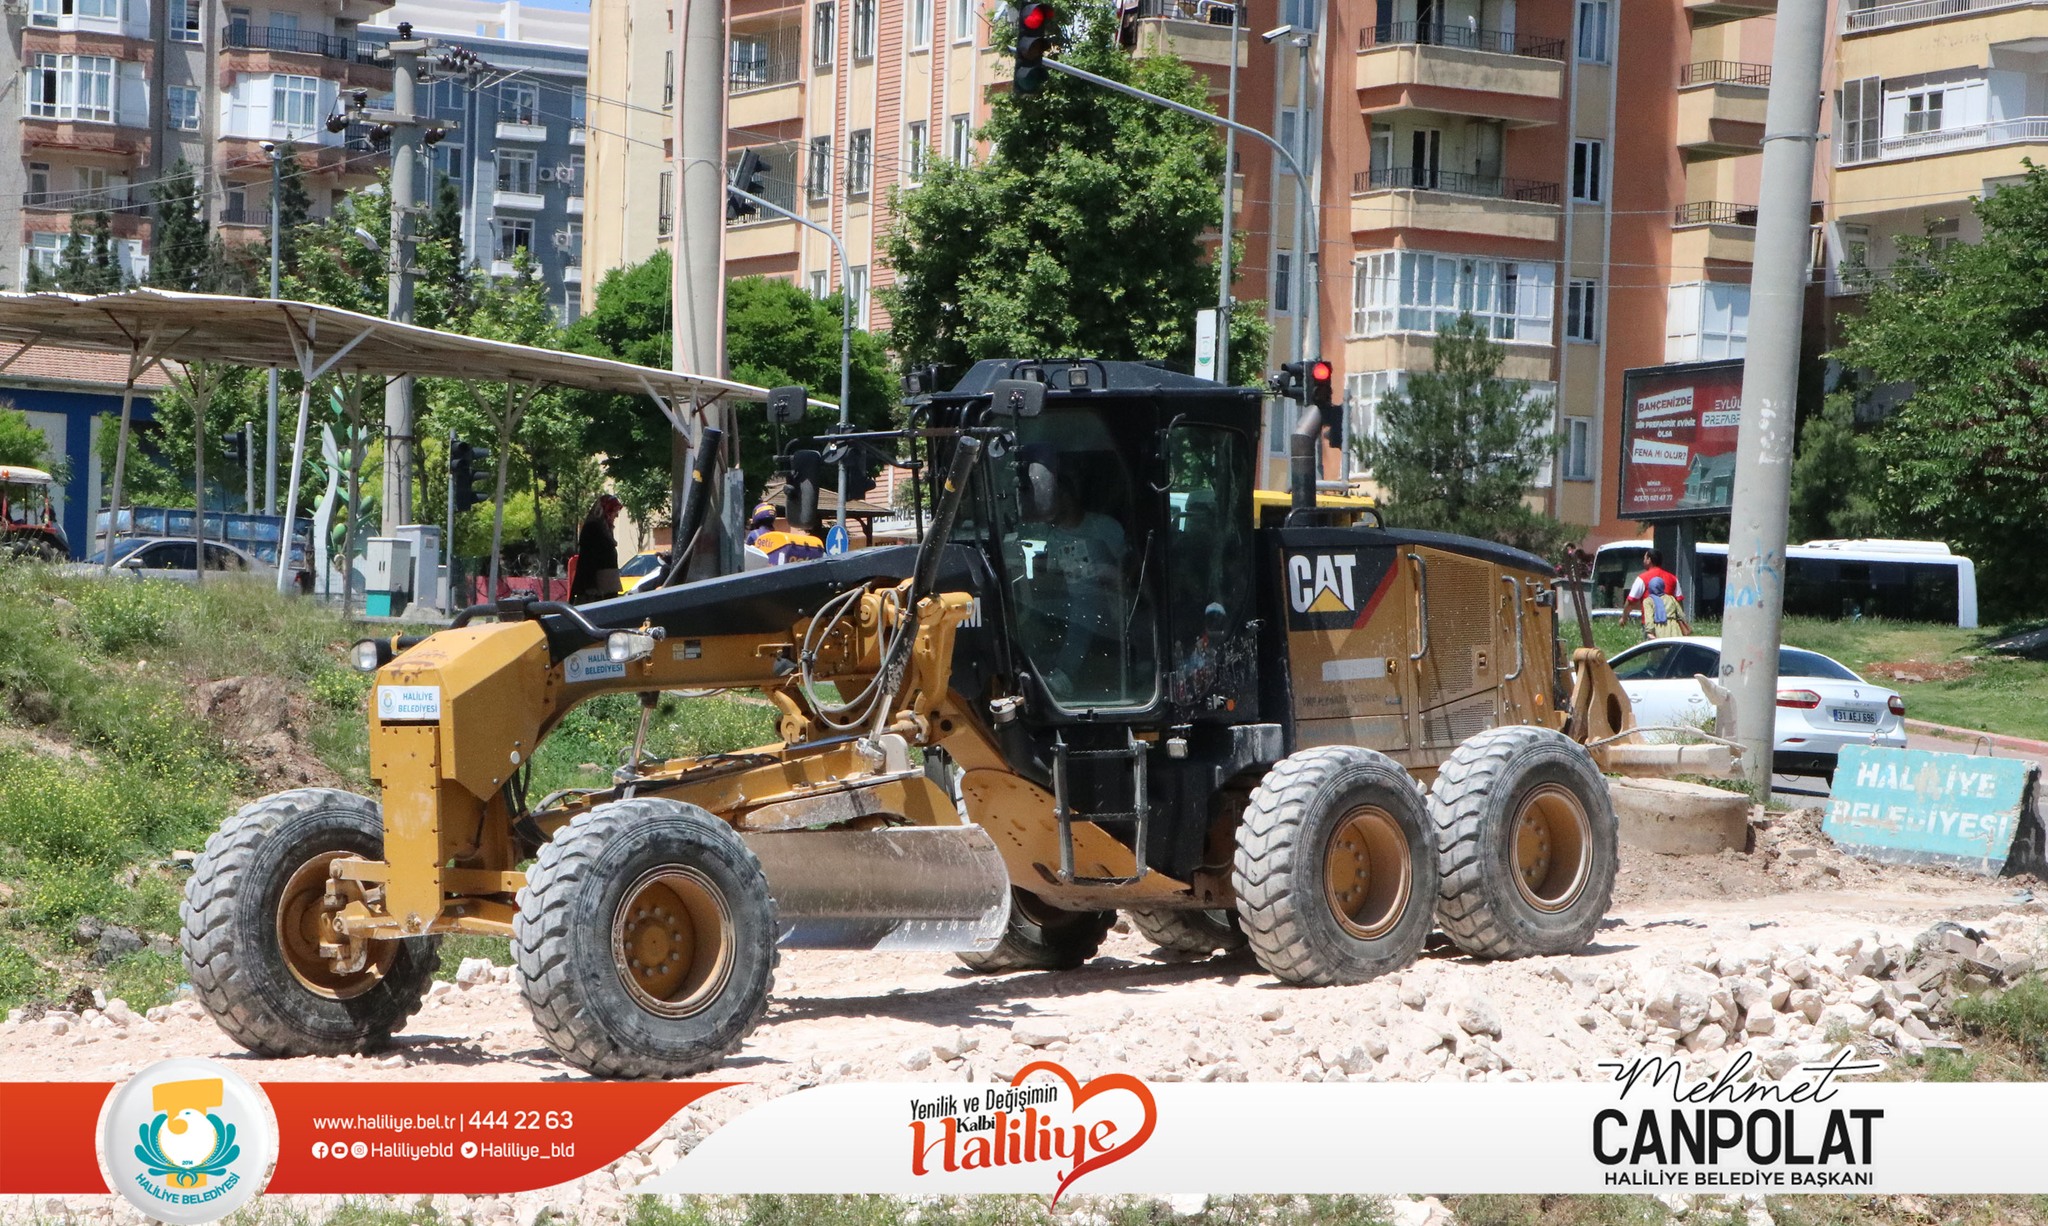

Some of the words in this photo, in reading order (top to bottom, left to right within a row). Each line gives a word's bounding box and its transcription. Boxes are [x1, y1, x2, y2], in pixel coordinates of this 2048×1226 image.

[1638, 395, 1692, 412] BAHÇENİZDE
[1715, 396, 1741, 410] EYLÜL
[1657, 430, 1673, 438] OLSA
[1634, 448, 1653, 457] FENA
[1663, 450, 1687, 460] OLUR?
[757, 537, 774, 548] getir
[1288, 554, 1356, 613] CAT
[585, 664, 623, 675] BELEDİYESİ
[403, 691, 433, 701] HALİLİYE
[398, 704, 438, 713] BELEDİYESİ
[1838, 711, 1846, 720] 31
[1849, 712, 1861, 721] AEJ
[1857, 761, 1996, 798] HALİLİYE
